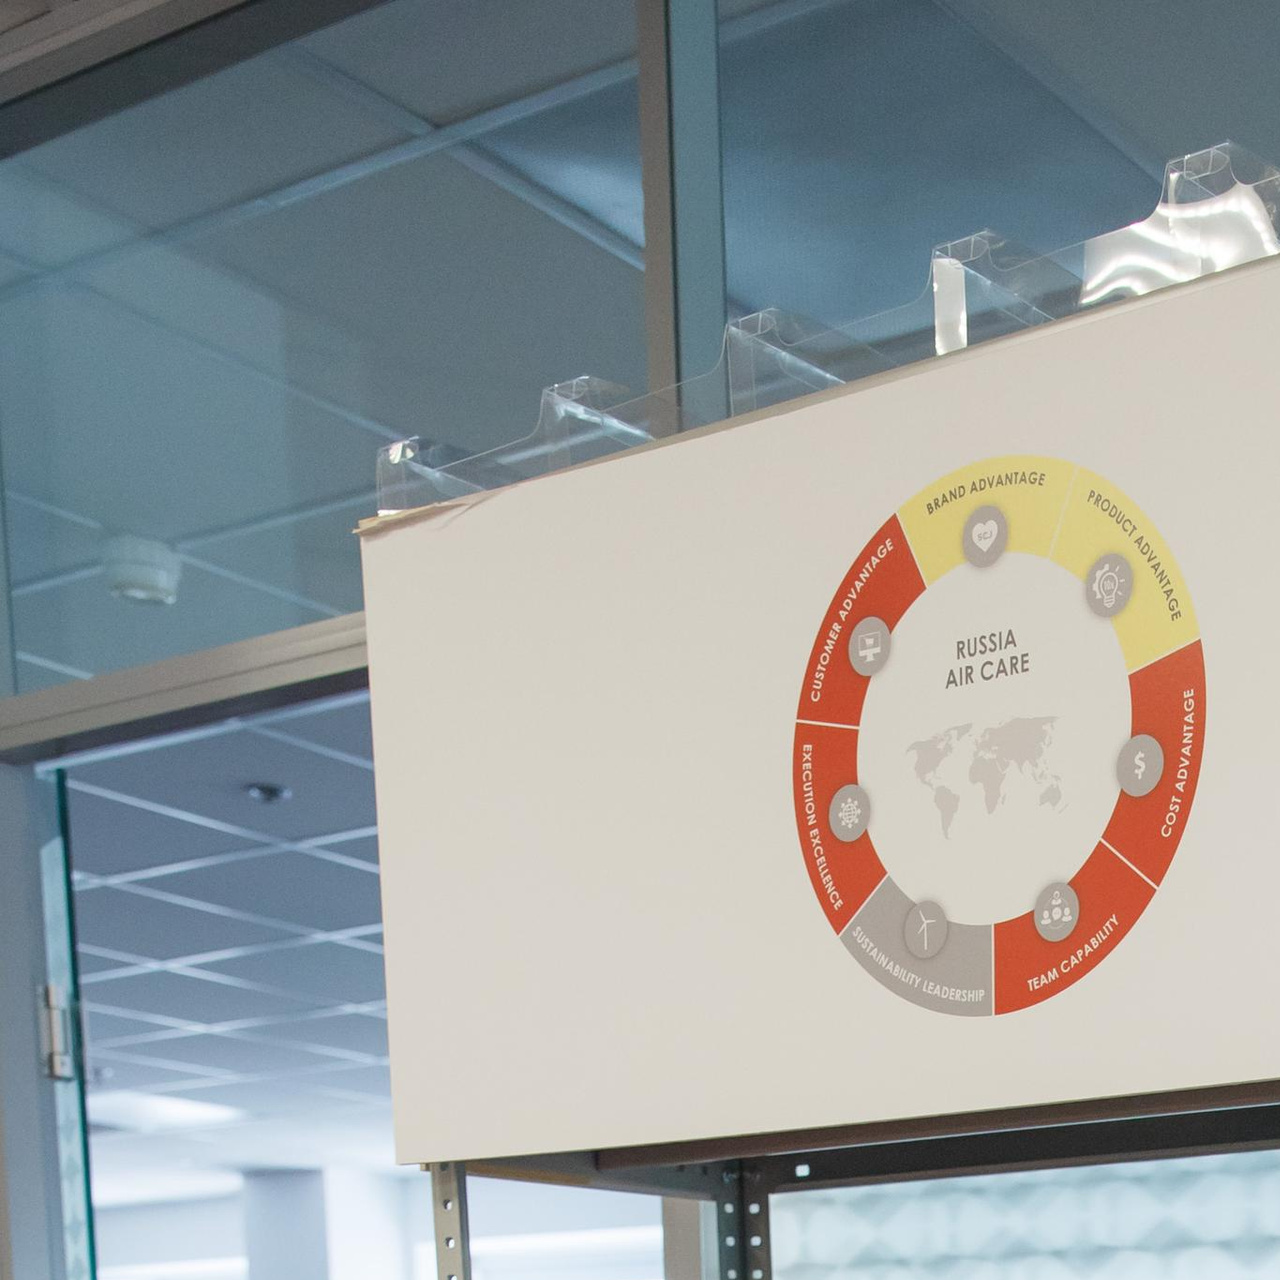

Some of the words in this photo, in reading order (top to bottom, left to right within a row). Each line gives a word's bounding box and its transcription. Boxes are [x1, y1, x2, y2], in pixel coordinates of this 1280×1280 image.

[926, 485, 966, 516] BRAND
[970, 471, 1047, 495] ADVANTAGE
[977, 531, 993, 542] SCJ
[1086, 489, 1138, 538] PRODUCT
[1133, 536, 1182, 622] ADVANTAGE
[811, 620, 843, 703] CUSTOMER
[838, 538, 895, 621] ADVANTAGE
[956, 629, 1017, 660] RUSSIA
[945, 665, 975, 690] AIR
[980, 653, 1030, 682] CARE
[802, 743, 819, 828] EXECUTION
[1160, 795, 1182, 838] COST
[1178, 688, 1195, 793] ADVANTAGE
[809, 828, 844, 912] EXCELLENCE
[852, 926, 922, 990] SUSTAINABILITY
[922, 979, 986, 1003] LEADERSHIP
[1026, 967, 1060, 993] TEAM
[1059, 913, 1121, 975] CAPABILITY
